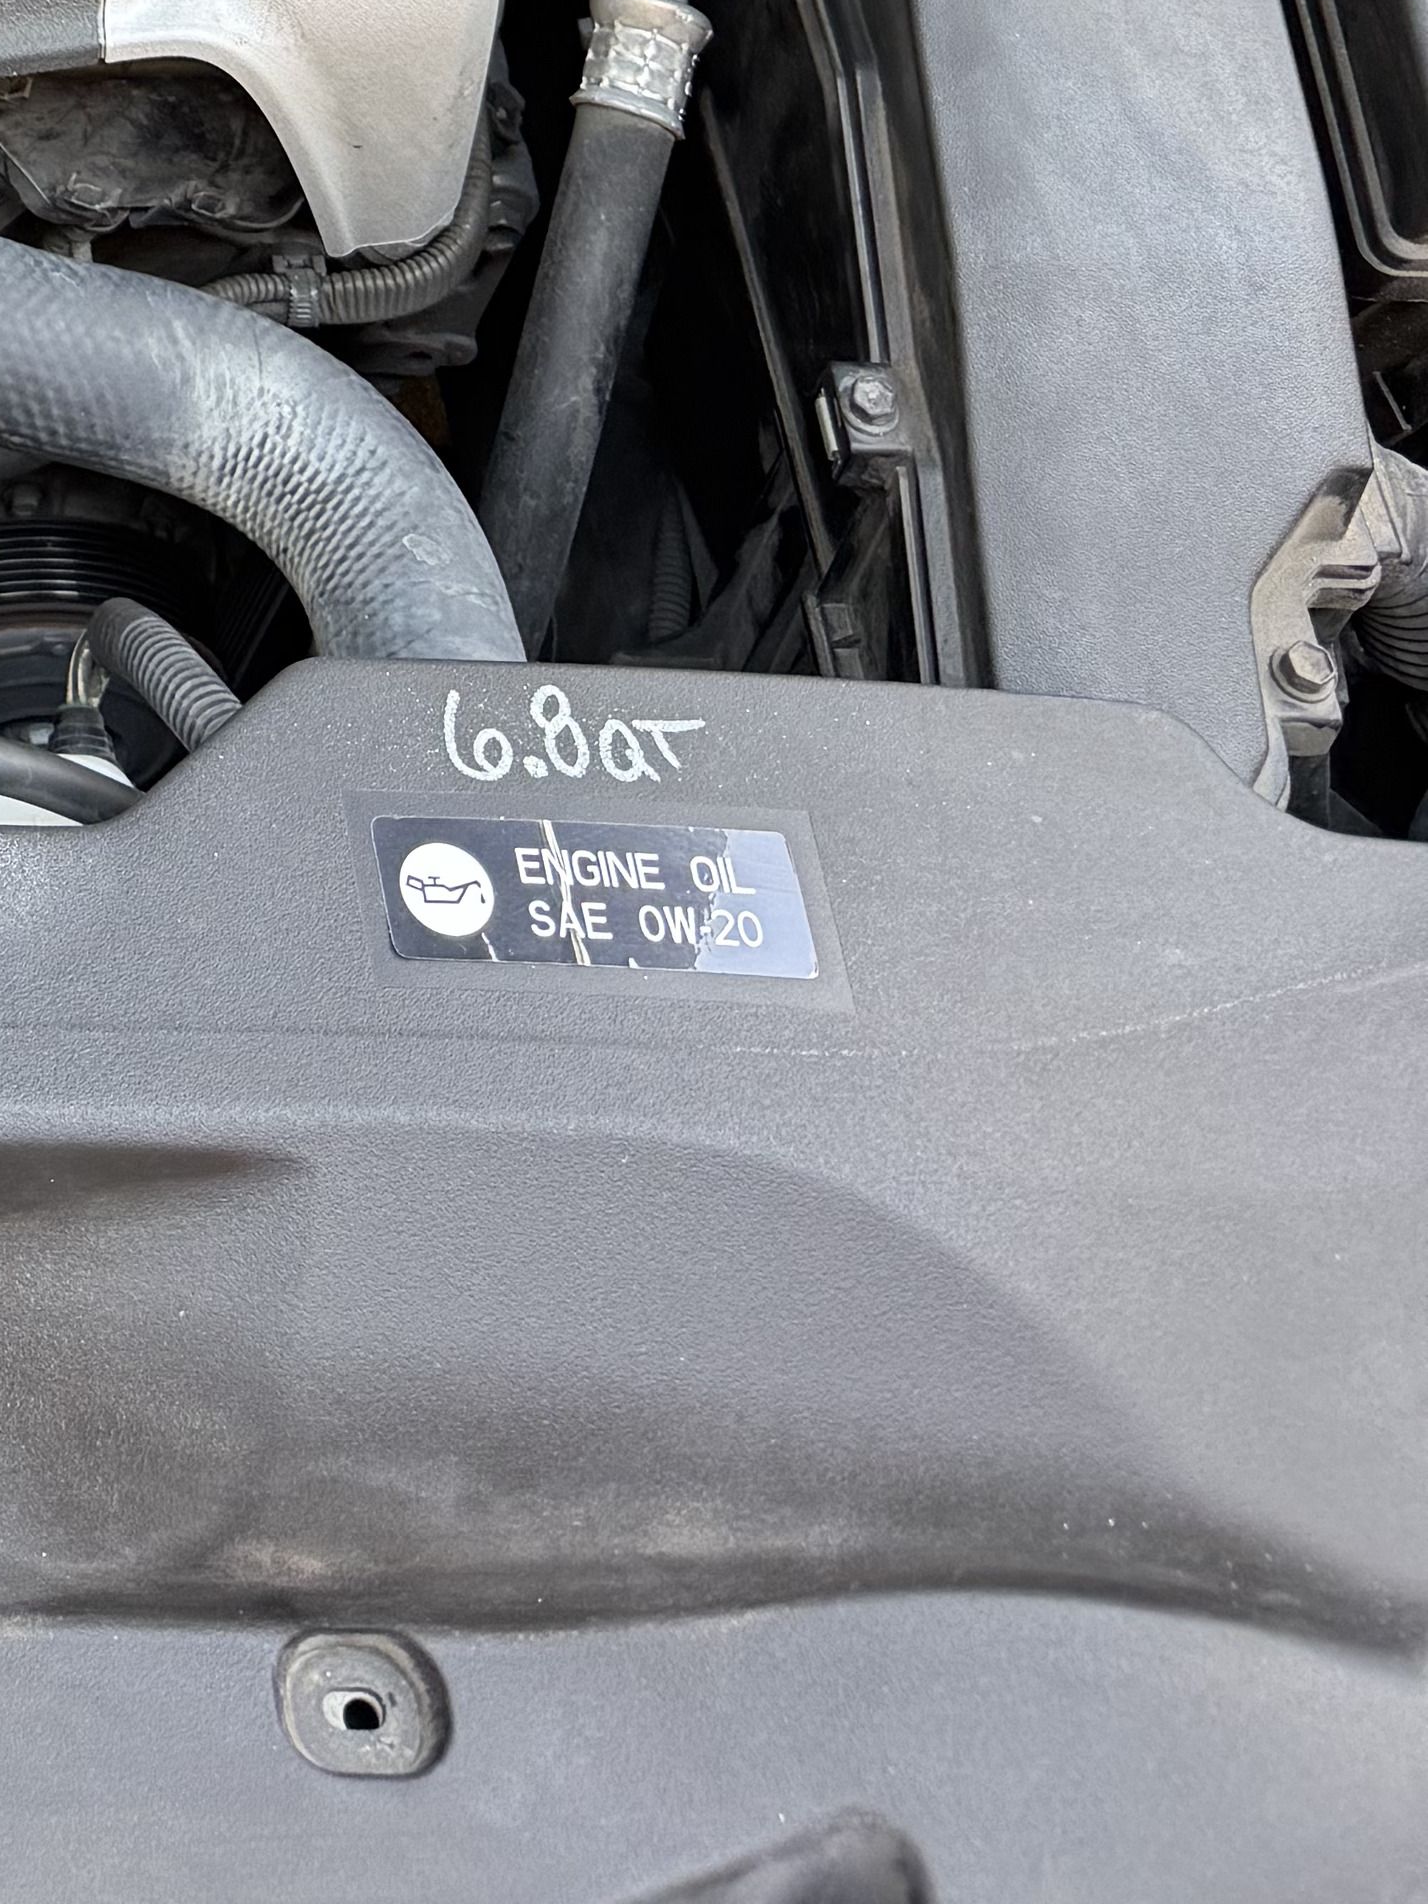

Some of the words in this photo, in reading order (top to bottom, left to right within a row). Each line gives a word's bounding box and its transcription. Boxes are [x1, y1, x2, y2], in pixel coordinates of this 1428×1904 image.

[514, 846, 665, 890] ENGINE
[689, 854, 757, 896] OIL
[529, 901, 614, 941] SAE
[639, 905, 764, 949] 0W-20
